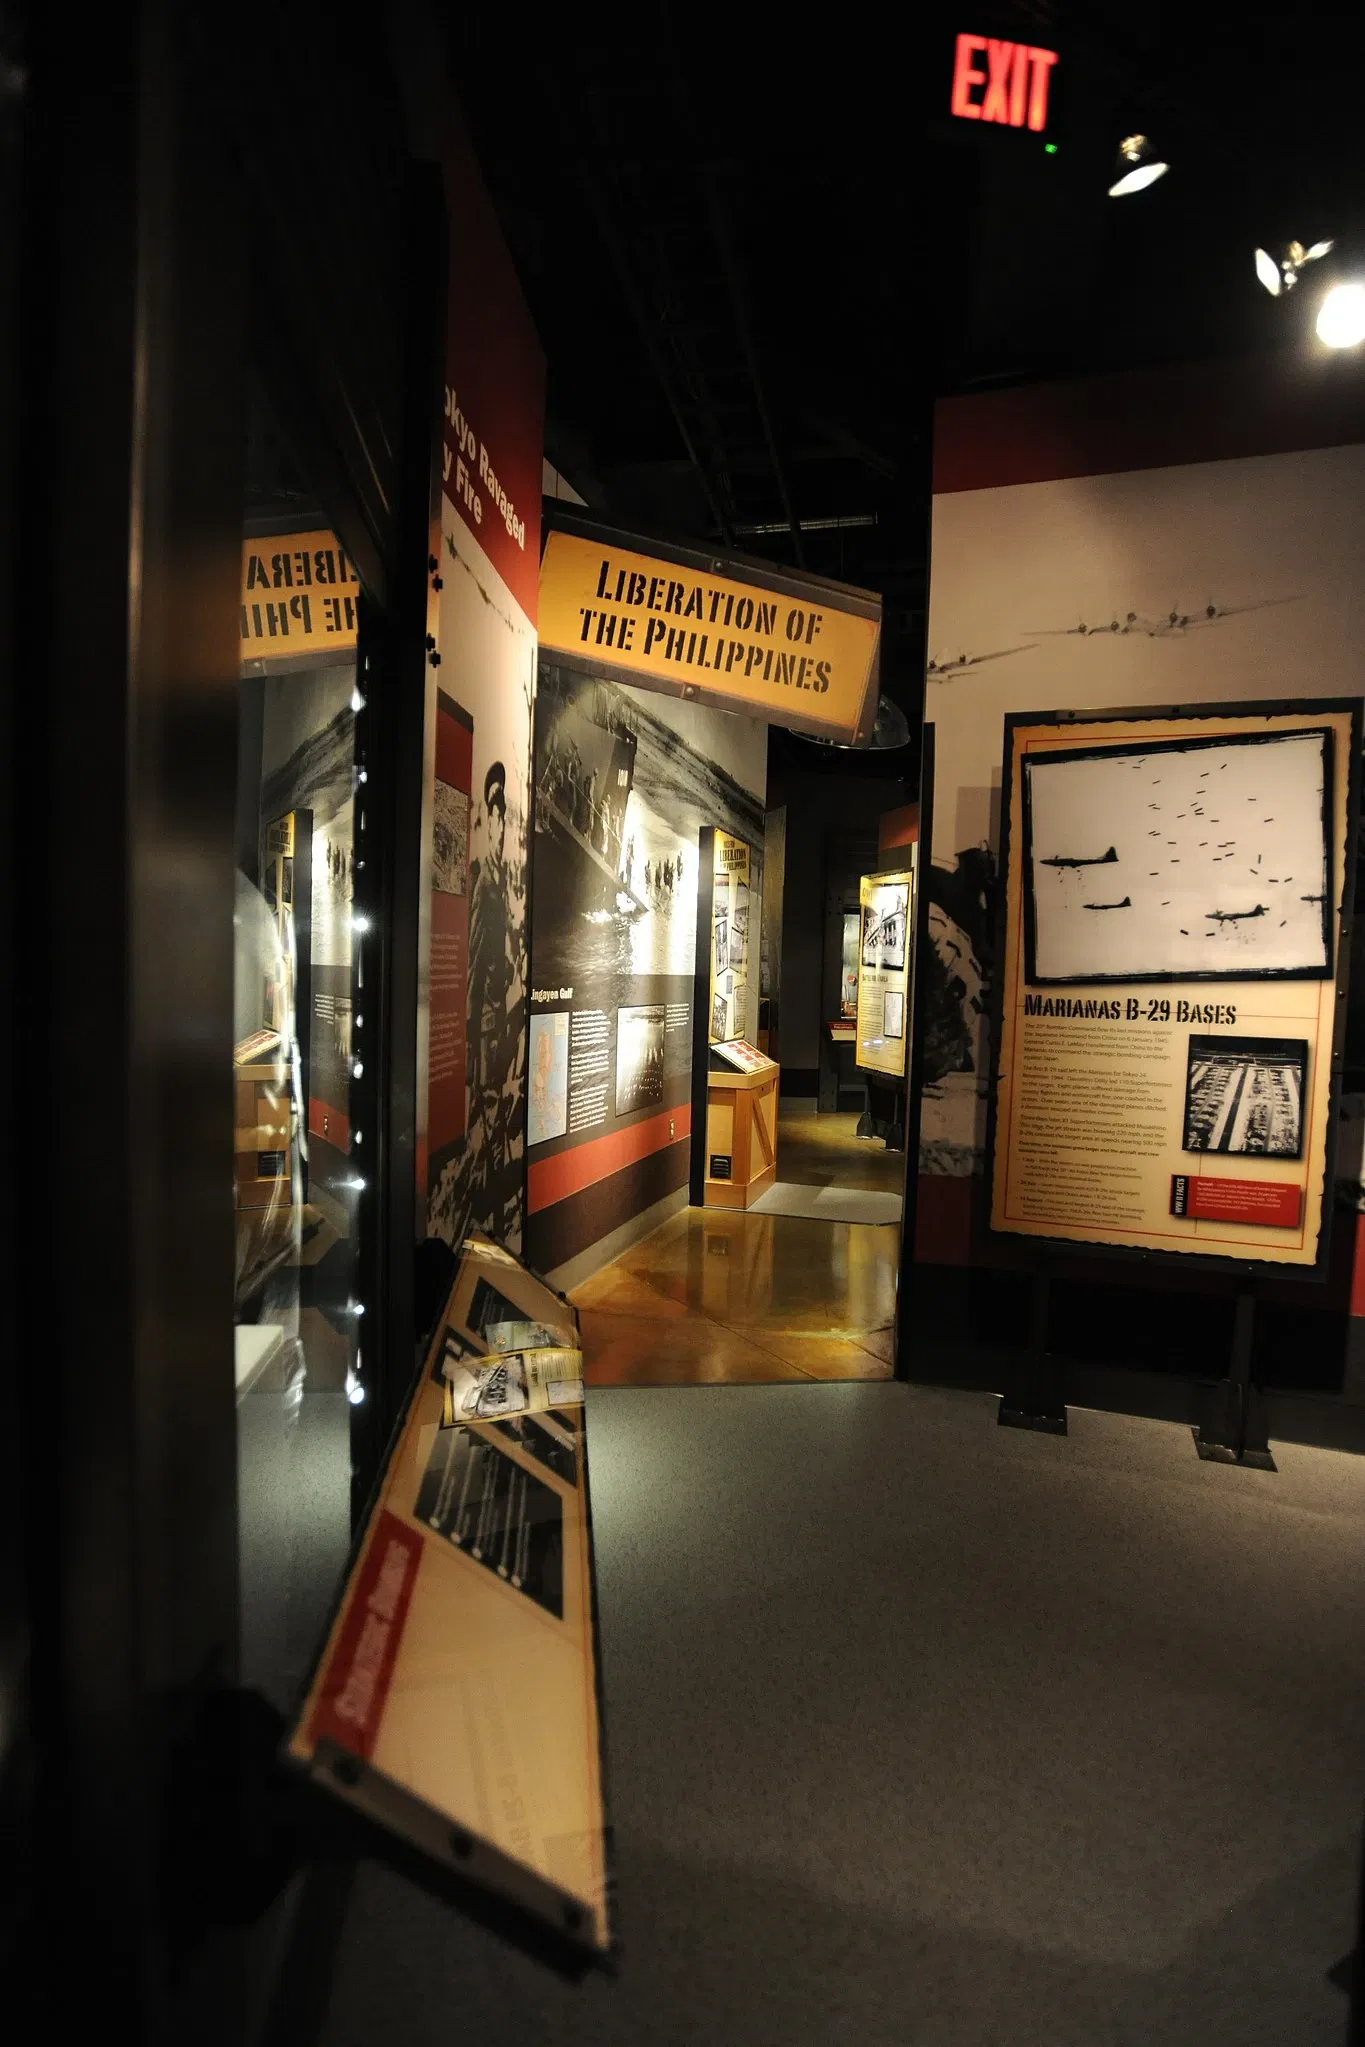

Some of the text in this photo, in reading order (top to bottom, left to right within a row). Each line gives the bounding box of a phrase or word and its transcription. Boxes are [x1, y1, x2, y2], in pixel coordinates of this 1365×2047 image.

[951, 33, 1059, 132] EXIT
[456, 456, 482, 524] Fire
[479, 442, 525, 550] Ravaged
[596, 560, 823, 645] LIBERATION OF
[580, 608, 832, 694] THE PHILIPPINES
[1024, 994, 1237, 1025] MARIANAS B-29 BASES
